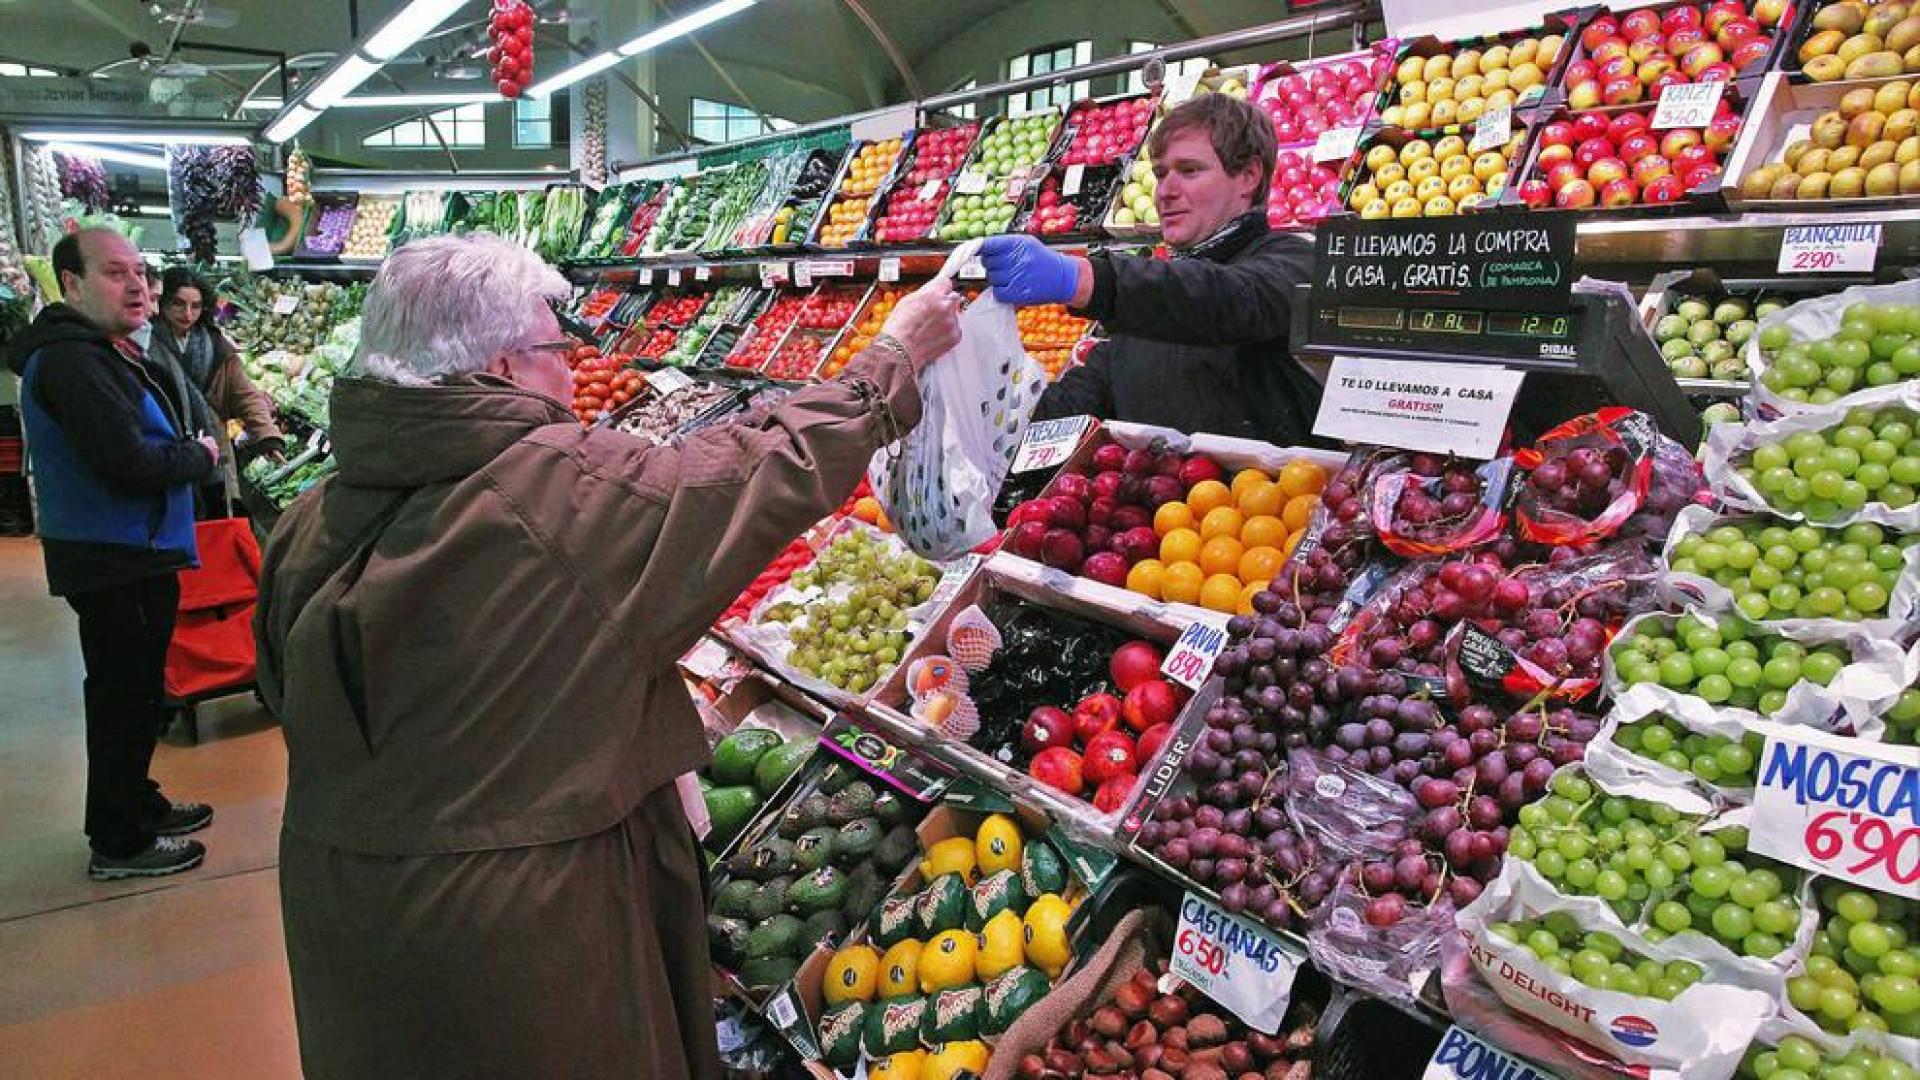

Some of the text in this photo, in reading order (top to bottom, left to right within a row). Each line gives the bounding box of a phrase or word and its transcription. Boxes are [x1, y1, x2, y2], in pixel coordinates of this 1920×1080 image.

[1328, 230, 1550, 257] LE LLEVAMOS LA COMPRA
[1327, 265, 1337, 290] A
[1341, 378, 1494, 401] TE LO LLEVAMOS A CASA
[1146, 737, 1189, 796] LIDER
[1500, 962, 1596, 1023] DELIGHT
